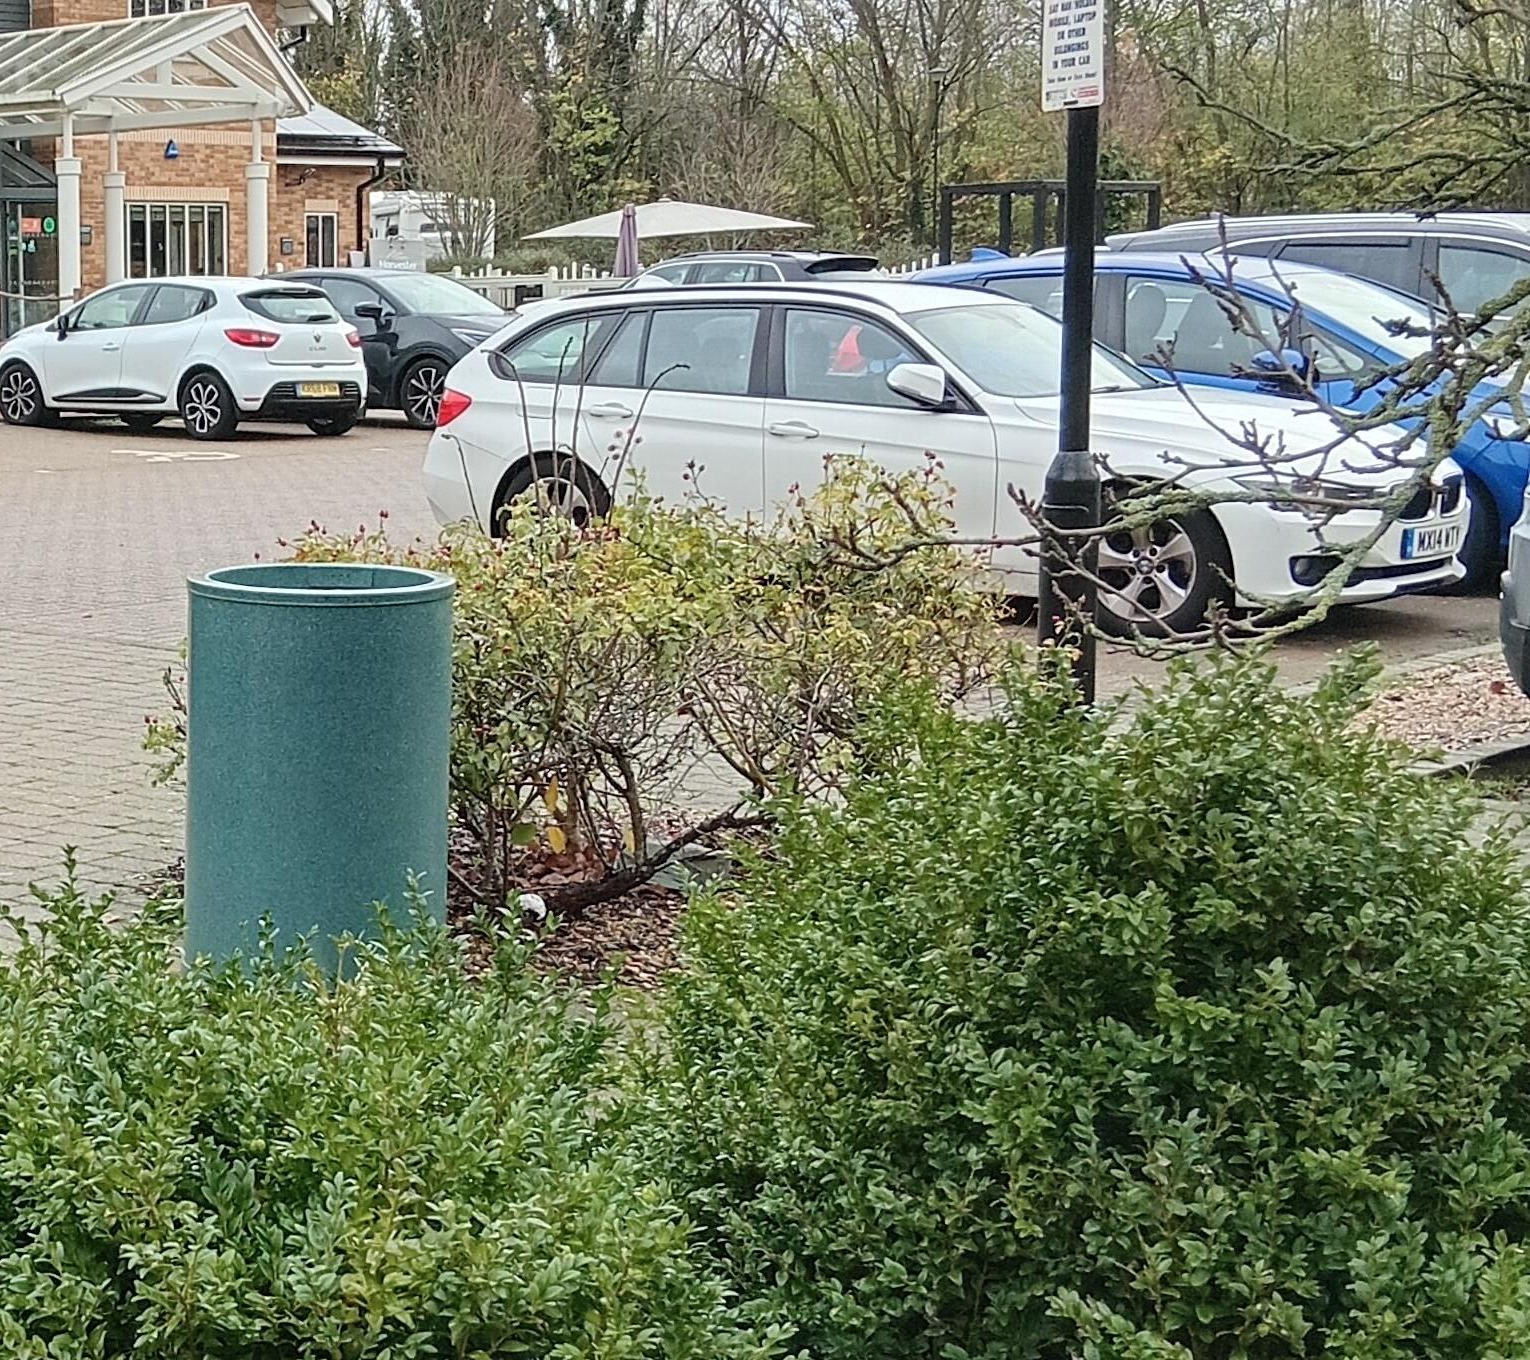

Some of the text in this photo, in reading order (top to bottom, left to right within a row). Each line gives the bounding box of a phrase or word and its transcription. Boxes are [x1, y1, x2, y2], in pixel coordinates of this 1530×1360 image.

[1074, 11, 1096, 23] LAPTOP
[1068, 27, 1086, 38] OTHER
[1061, 57, 1075, 68] YOUR
[1079, 55, 1090, 65] CAR
[1417, 529, 1443, 552] MX14
